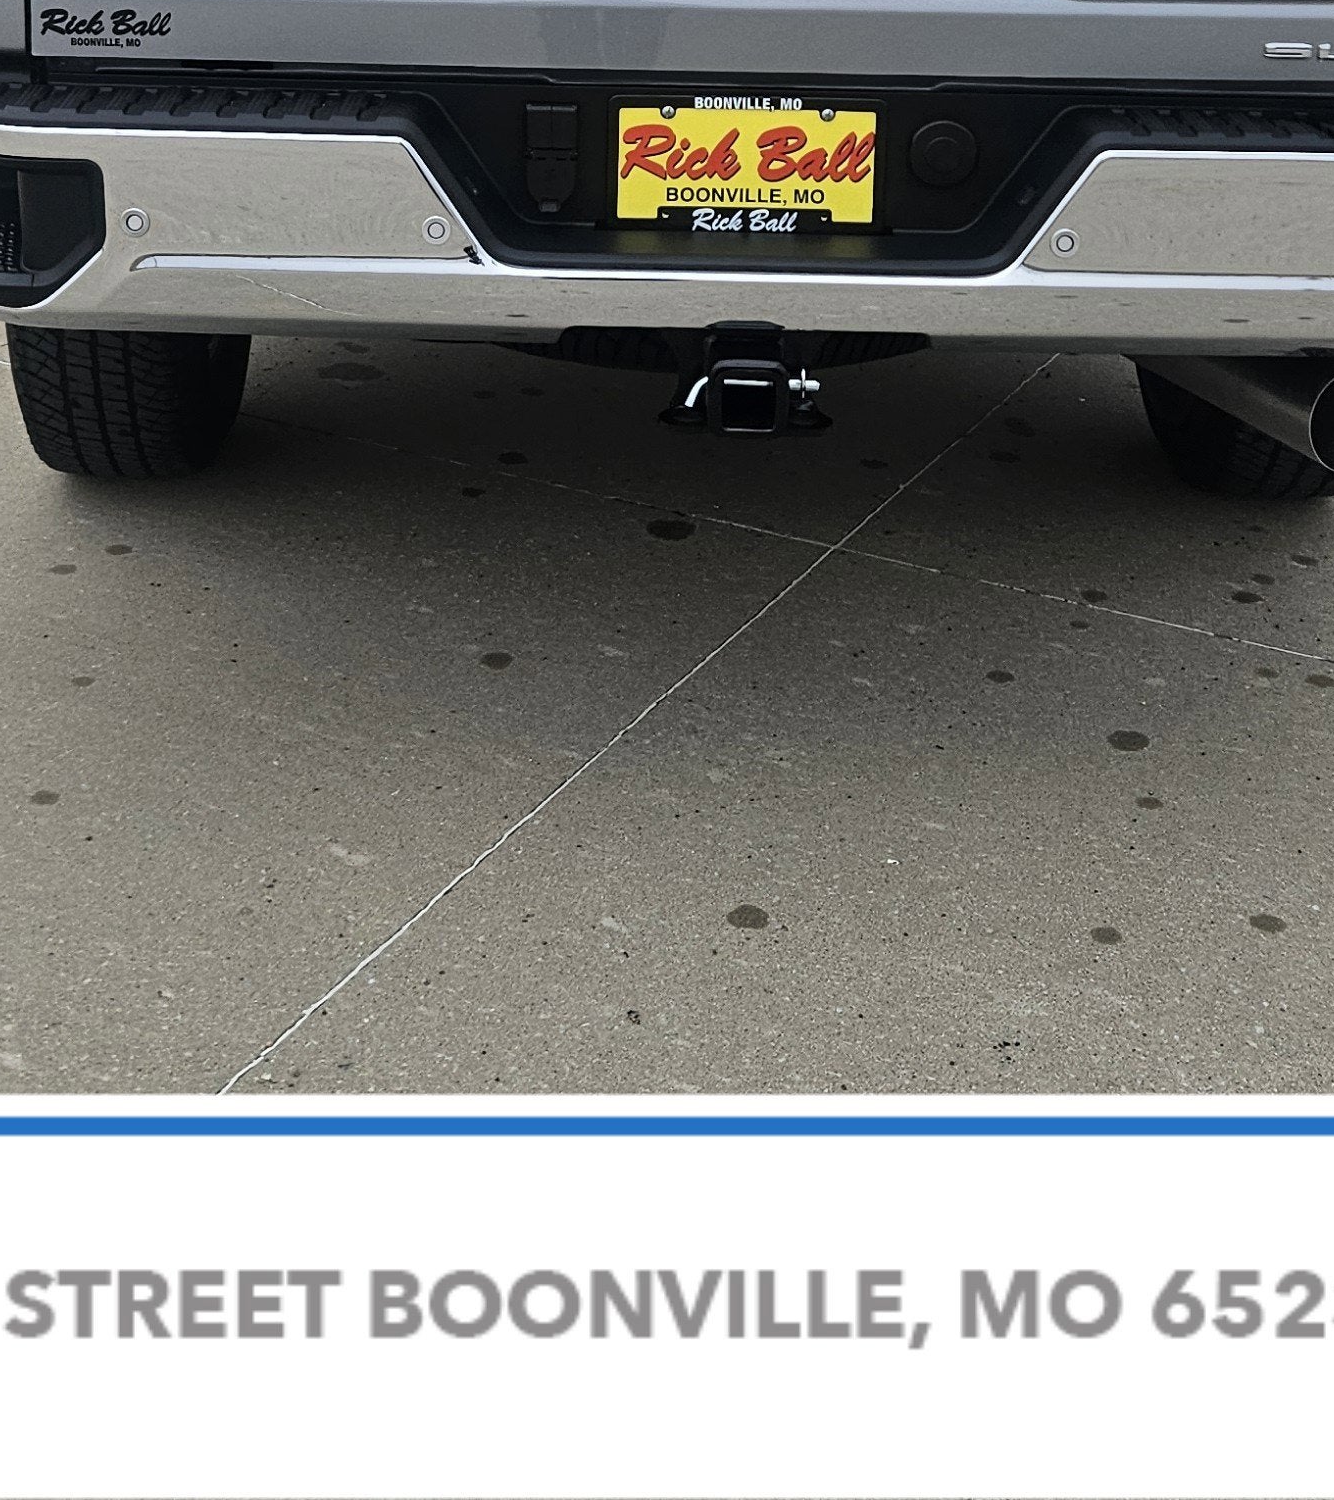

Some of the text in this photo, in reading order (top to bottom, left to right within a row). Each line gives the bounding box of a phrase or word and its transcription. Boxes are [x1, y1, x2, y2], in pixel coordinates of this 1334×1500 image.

[40, 8, 172, 36] Rick Ball
[70, 38, 141, 48] BOONVILLE, MO
[694, 96, 803, 112] BOONVILLE, MO
[620, 123, 876, 183] Rick Ball
[665, 187, 825, 206] BOONVILLE, MO
[691, 208, 798, 233] Rick Ball
